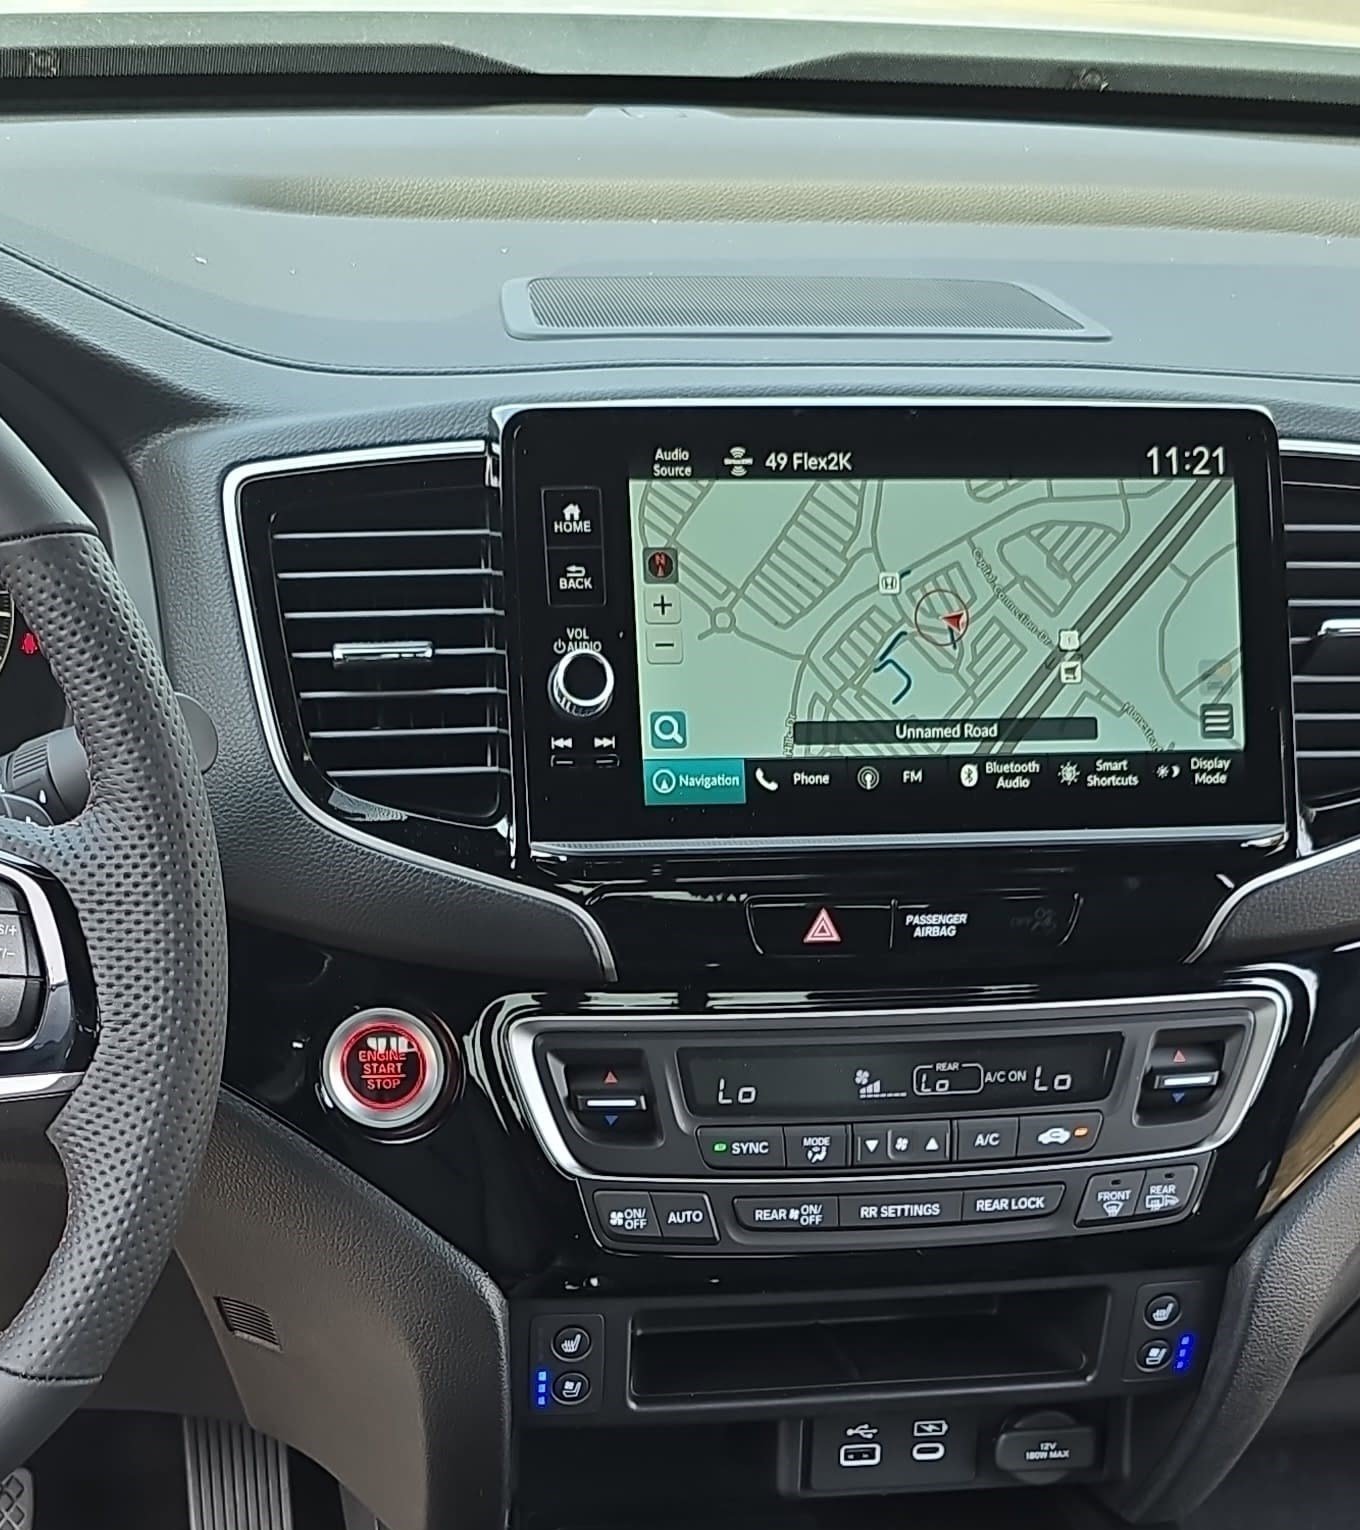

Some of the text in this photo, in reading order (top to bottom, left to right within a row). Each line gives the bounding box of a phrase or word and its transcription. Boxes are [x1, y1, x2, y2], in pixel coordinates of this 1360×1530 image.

[655, 448, 689, 460] Audio
[765, 453, 787, 471] 49
[793, 453, 852, 471] Flex2K
[1147, 446, 1226, 475] 11:21
[653, 463, 692, 477] Source
[554, 520, 591, 533] HOME
[559, 578, 592, 590] BACK
[567, 628, 589, 640] VOL
[567, 641, 602, 652] AUDIO
[896, 722, 998, 739] Unnamed Road
[986, 761, 1040, 775] Bluetooth
[1096, 759, 1128, 772] Smart
[1191, 758, 1231, 773] Display
[679, 774, 740, 788] Navigation
[793, 772, 830, 786] Phone
[903, 770, 923, 783] FM
[996, 776, 1030, 789] Audio
[1087, 773, 1139, 787] Shortcuts
[1195, 772, 1227, 784] Mode
[906, 913, 968, 926] PASSENGER
[914, 926, 956, 938] AIRBAG
[359, 1050, 406, 1062] ENGINE
[363, 1063, 403, 1074] START
[936, 1062, 959, 1071] REAR
[985, 1071, 1027, 1083] A/C ON
[367, 1079, 401, 1089] STOP
[803, 1137, 830, 1146] MODE
[975, 1133, 1000, 1146] A/C
[732, 1142, 769, 1154] SYNC
[1098, 1190, 1131, 1201] FRONT
[1150, 1185, 1176, 1196] REAR
[976, 1196, 1045, 1211] REAR LOCK
[624, 1208, 646, 1220] ON/
[668, 1210, 703, 1223] AUTO
[755, 1204, 822, 1220] REAR ON/
[860, 1203, 940, 1218] RR SETTINGS
[625, 1219, 647, 1230] OFF
[800, 1215, 823, 1225] OFF
[1040, 1442, 1057, 1451] 12V
[1049, 1450, 1070, 1458] MAX
